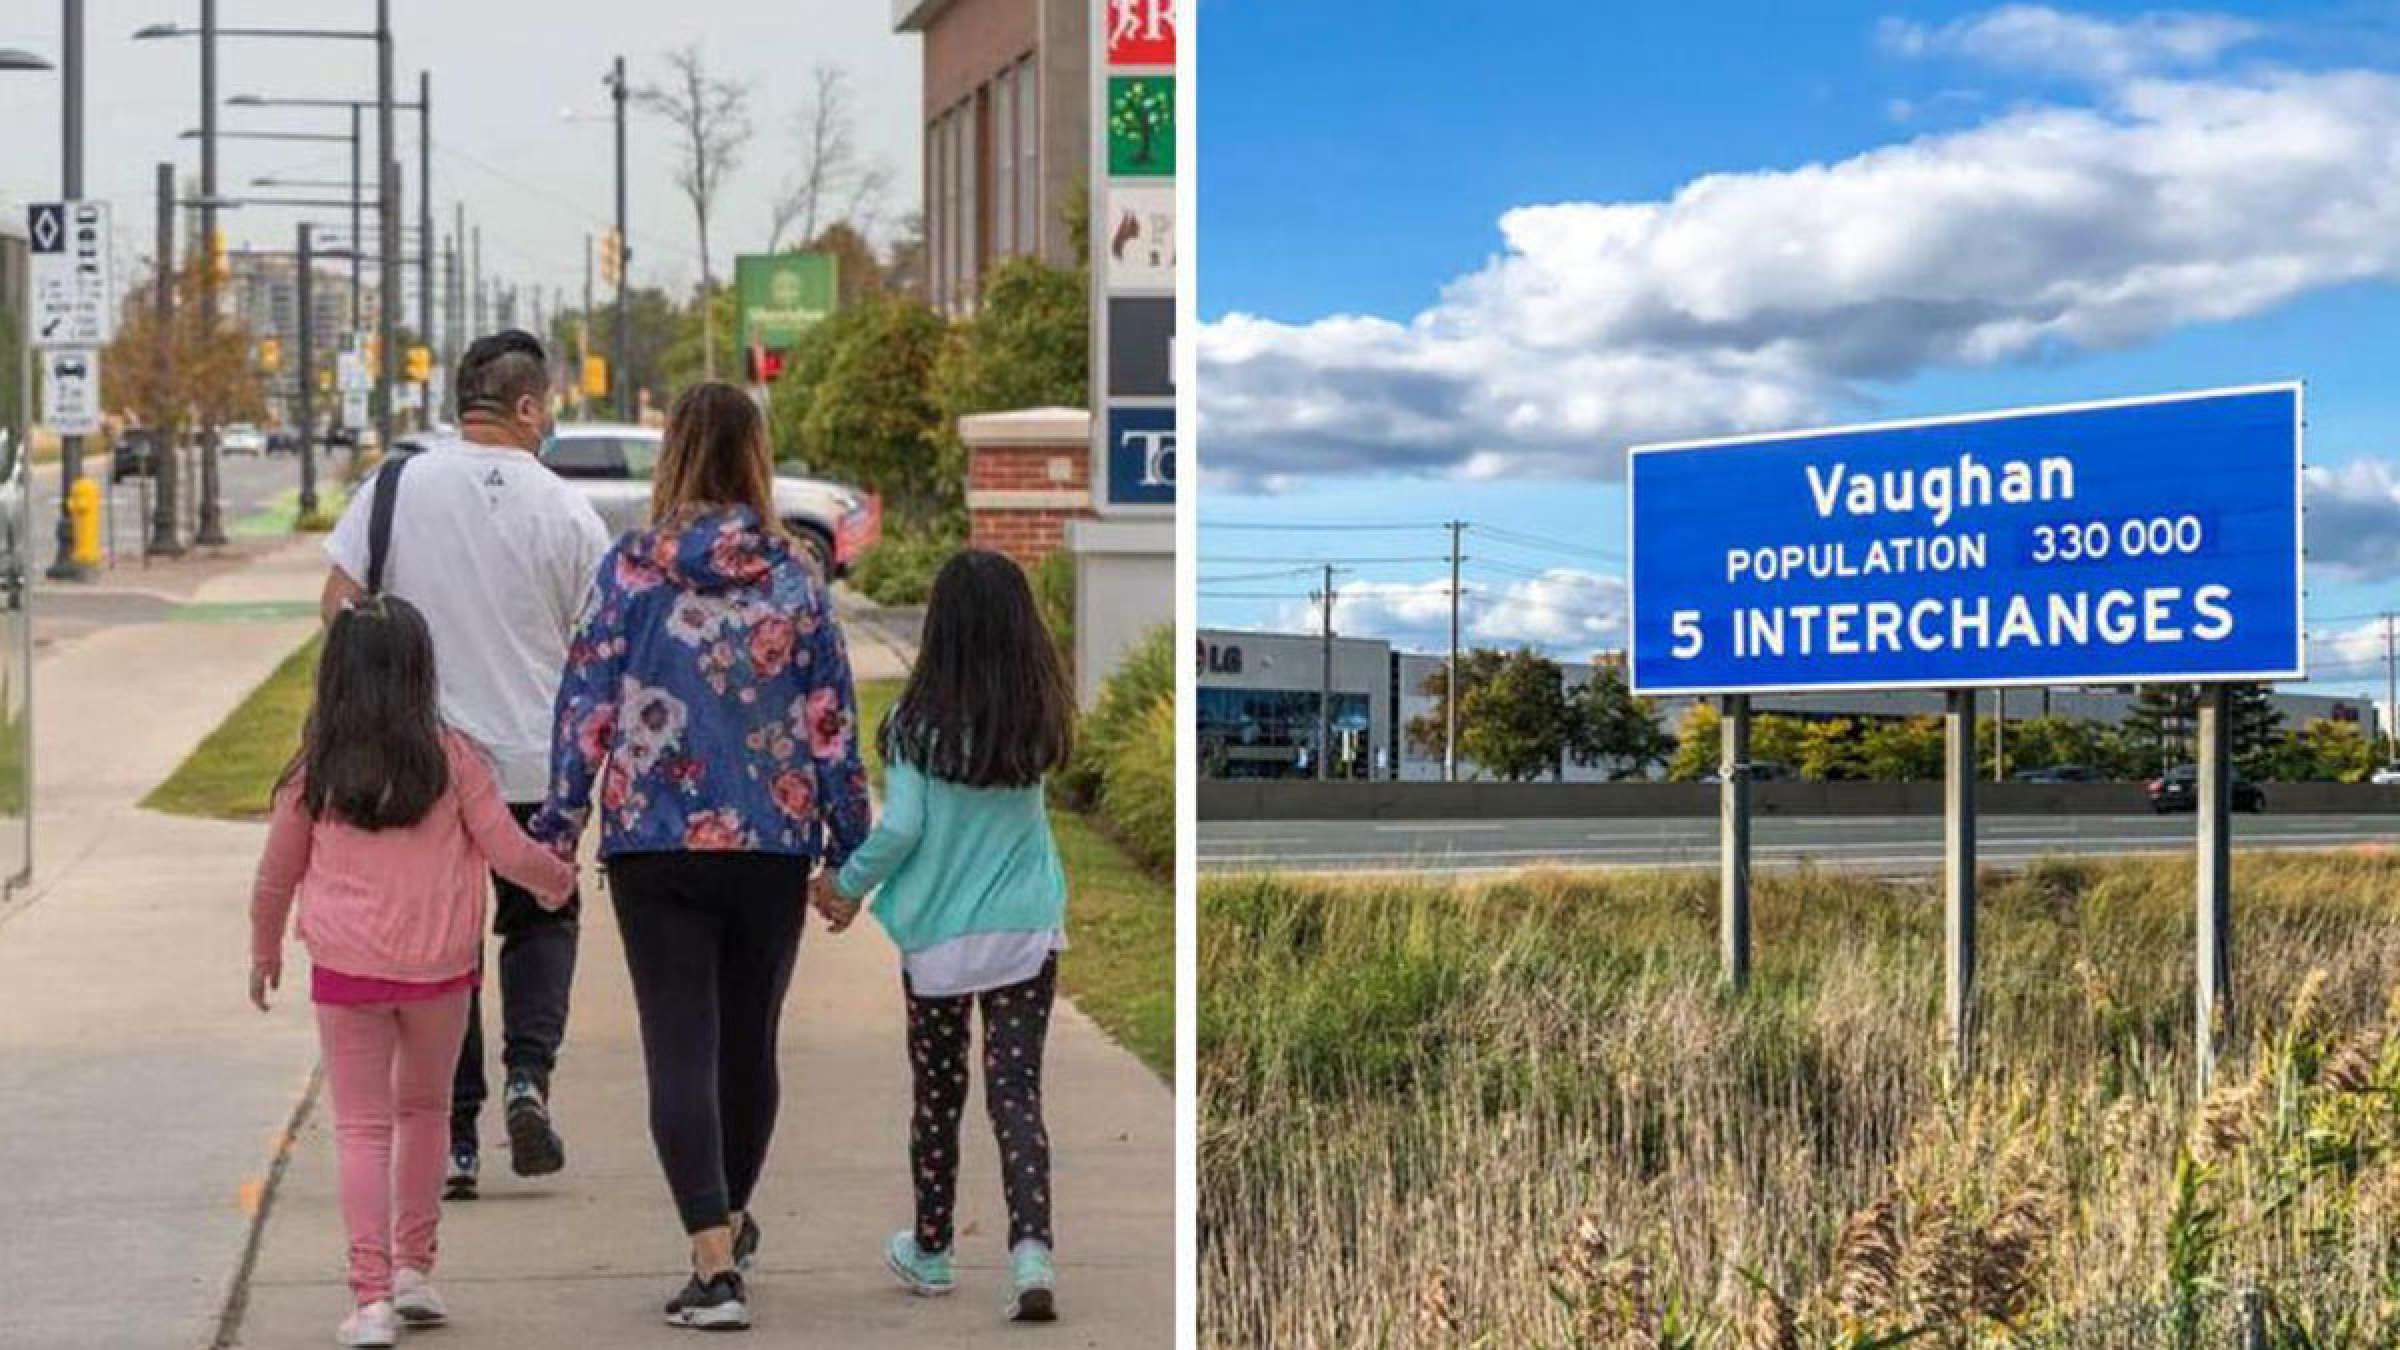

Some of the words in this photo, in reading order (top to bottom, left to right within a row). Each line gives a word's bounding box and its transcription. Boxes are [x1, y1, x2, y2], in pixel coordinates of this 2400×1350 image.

[1805, 452, 2074, 527] Vaughan
[1727, 533, 1987, 583] POPULATION
[2032, 521, 2112, 563] 330
[2120, 515, 2202, 556] 000
[1671, 609, 1703, 659] 5
[1732, 583, 2234, 657] INTERCHANGES
